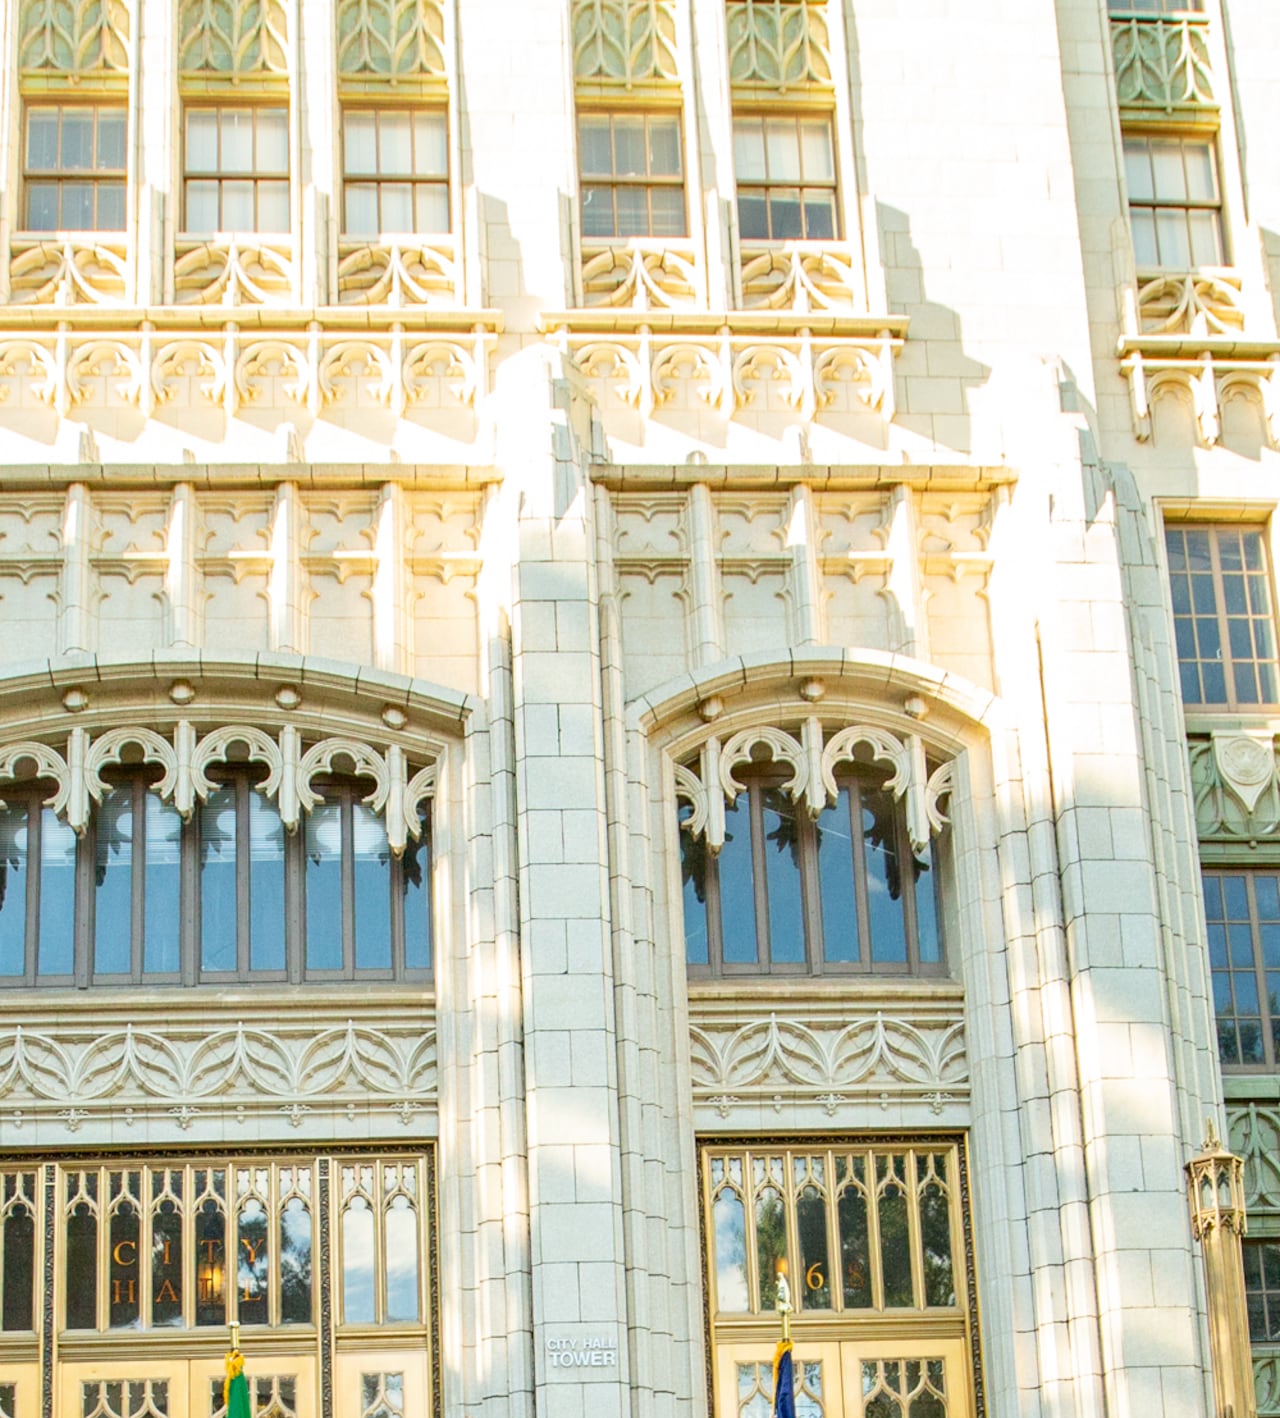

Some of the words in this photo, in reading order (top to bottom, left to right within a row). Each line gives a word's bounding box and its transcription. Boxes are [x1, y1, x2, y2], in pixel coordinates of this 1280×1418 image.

[113, 1238, 264, 1266] CITY
[112, 1278, 262, 1304] HALL
[547, 1338, 576, 1350] CITY
[583, 1337, 616, 1349] HALL
[549, 1351, 616, 1367] TOWER
